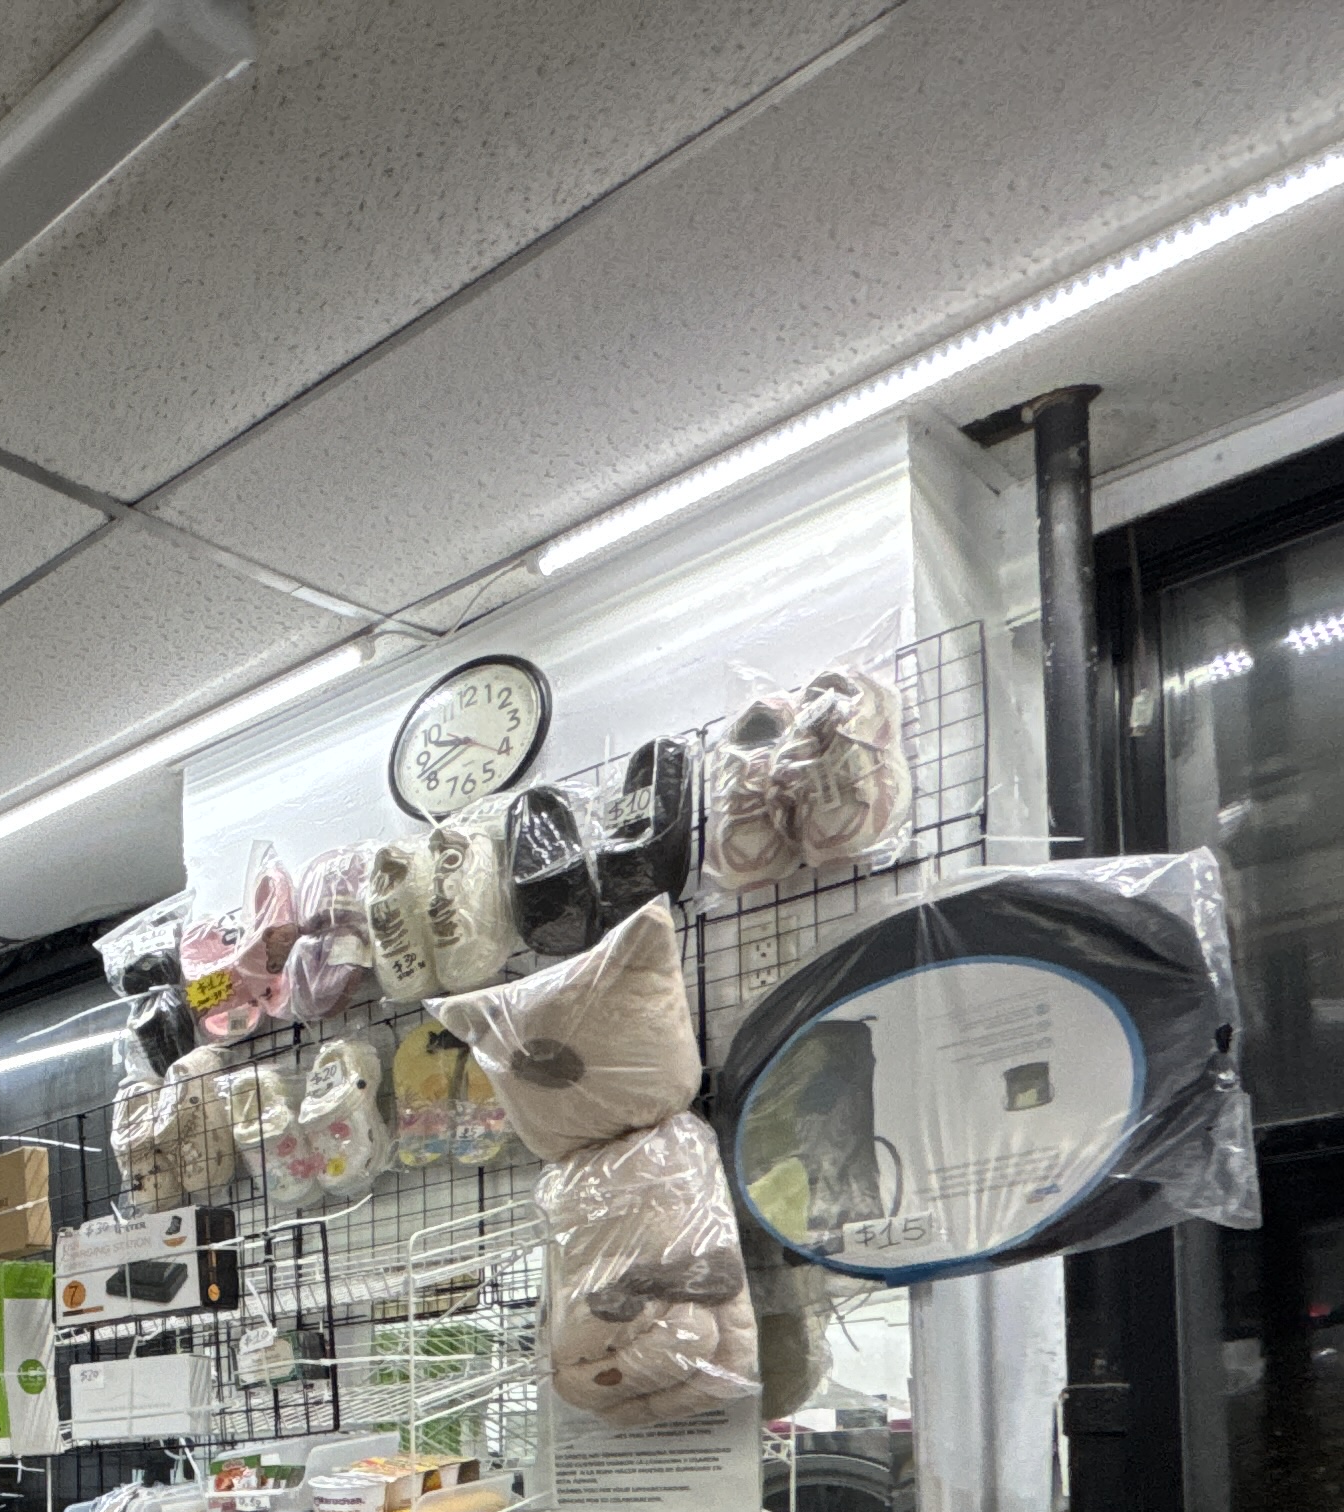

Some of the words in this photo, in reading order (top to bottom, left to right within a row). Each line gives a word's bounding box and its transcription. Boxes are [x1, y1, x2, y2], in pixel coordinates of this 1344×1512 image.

[457, 684, 478, 710] 12
[484, 683, 493, 704] 1
[497, 687, 513, 710] 2
[506, 708, 521, 732] 3
[422, 723, 442, 748] 10
[497, 736, 514, 756] 4
[416, 750, 431, 772] 9
[482, 760, 496, 784] 5
[426, 770, 440, 791] 8
[445, 776, 459, 797] 7
[461, 772, 477, 794] 6
[608, 785, 651, 821] $10
[853, 1217, 927, 1249] $15
[68, 1285, 79, 1307] 7
